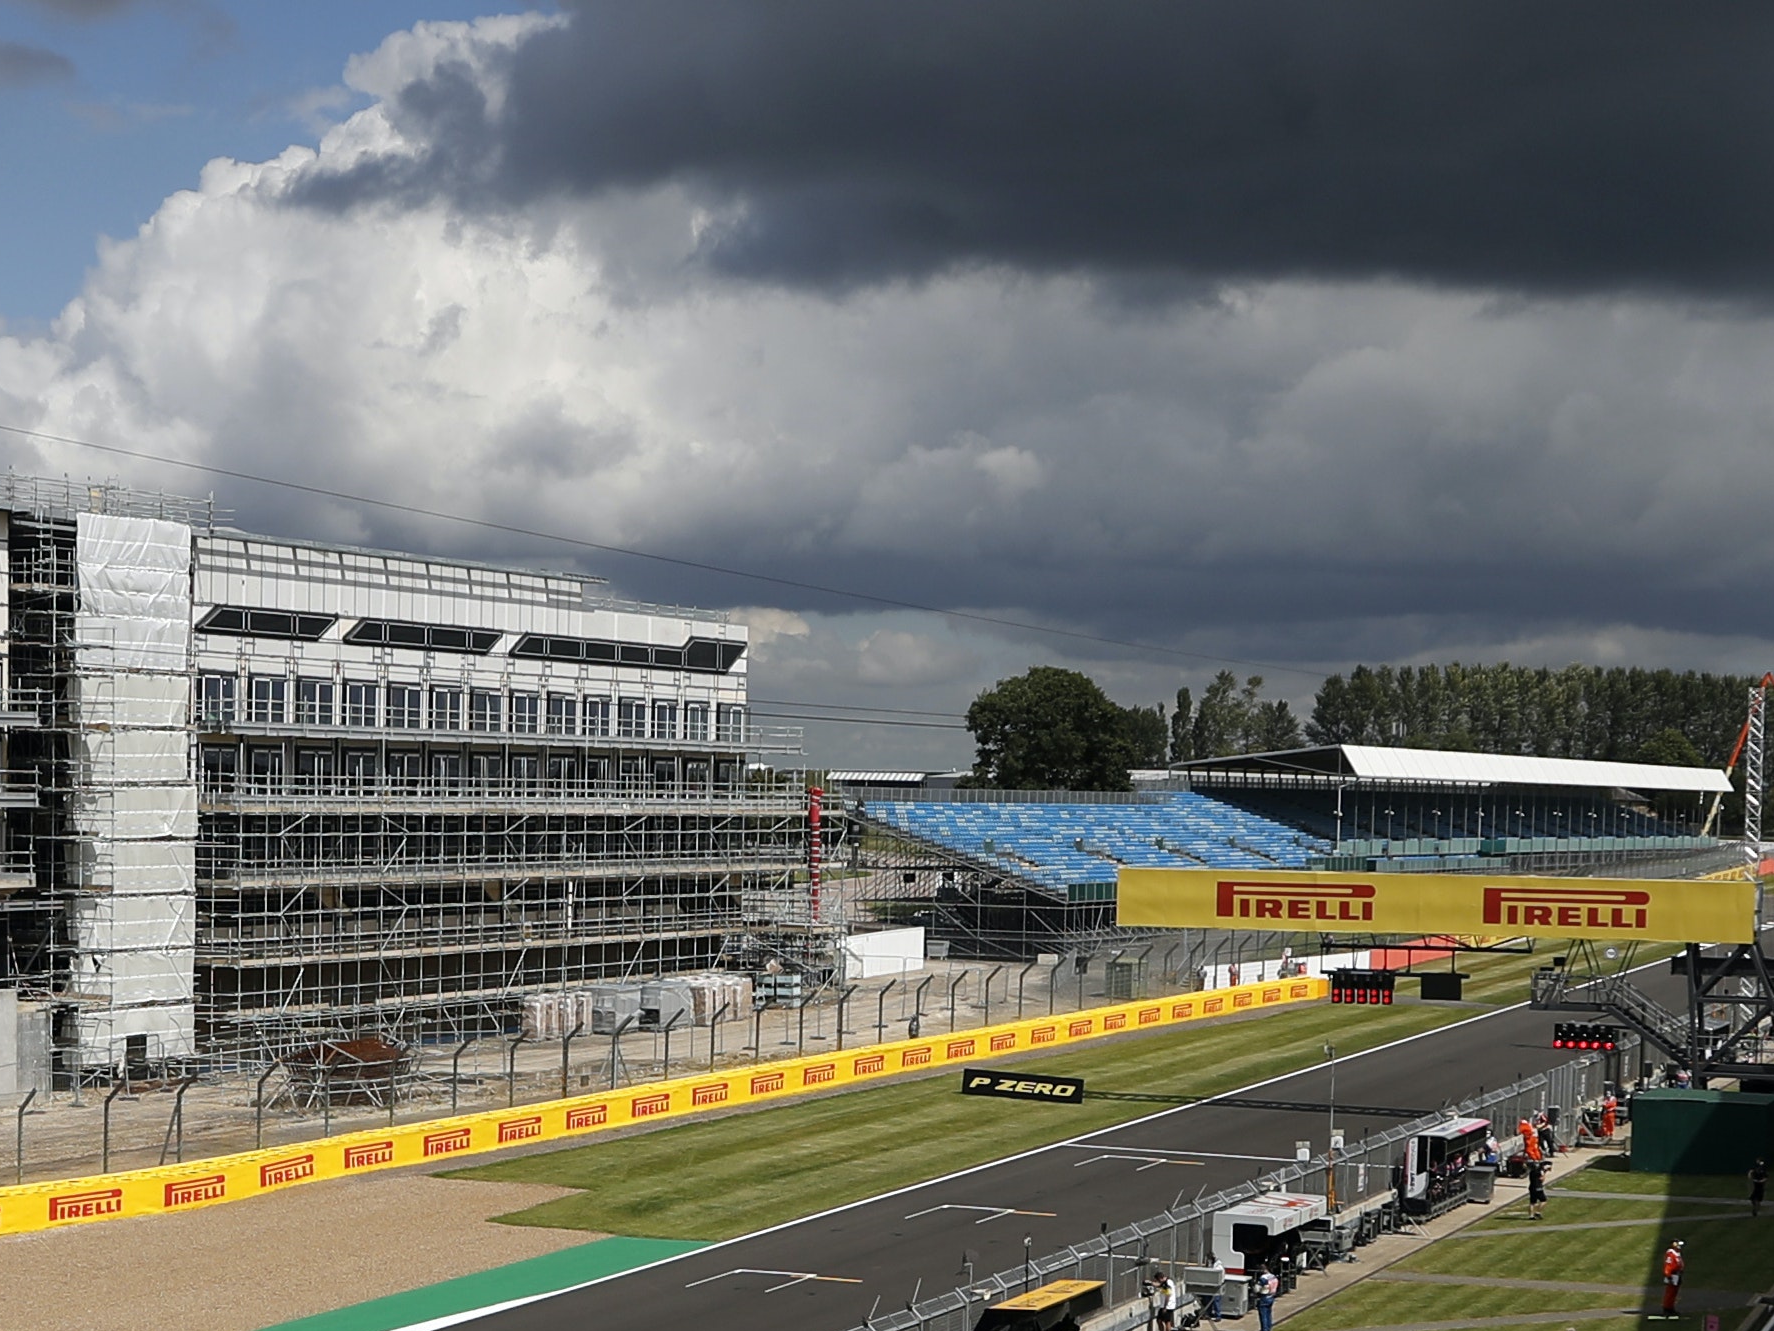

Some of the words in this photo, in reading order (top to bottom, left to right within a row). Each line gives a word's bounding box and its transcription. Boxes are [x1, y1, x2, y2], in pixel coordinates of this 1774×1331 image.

[1217, 881, 1376, 921] PIRELLI
[1483, 887, 1650, 928] PIRELLI
[1031, 1026, 1055, 1044] PIRELLI
[1069, 1020, 1092, 1037] PIRELLI
[947, 1040, 975, 1058] PIRELLI
[991, 1033, 1015, 1051] PIRELLI
[854, 1055, 884, 1075] PIRELLI
[902, 1047, 931, 1067] PIRELLI
[751, 1073, 784, 1095] PIRELLI
[804, 1064, 836, 1085] PIRELLI
[692, 1083, 728, 1105] PIRELLI
[969, 1077, 991, 1088] P
[994, 1079, 1076, 1097] ZERO
[632, 1094, 670, 1117] PIRELLI
[566, 1105, 607, 1130] PIRELLI
[498, 1116, 541, 1143] PIRELLI
[424, 1128, 470, 1156] PIRELLI
[344, 1141, 393, 1168] PIRELLI
[260, 1154, 313, 1187] PIRELLI
[164, 1175, 225, 1207] PIRELLI
[49, 1188, 122, 1221] PIRELLI
